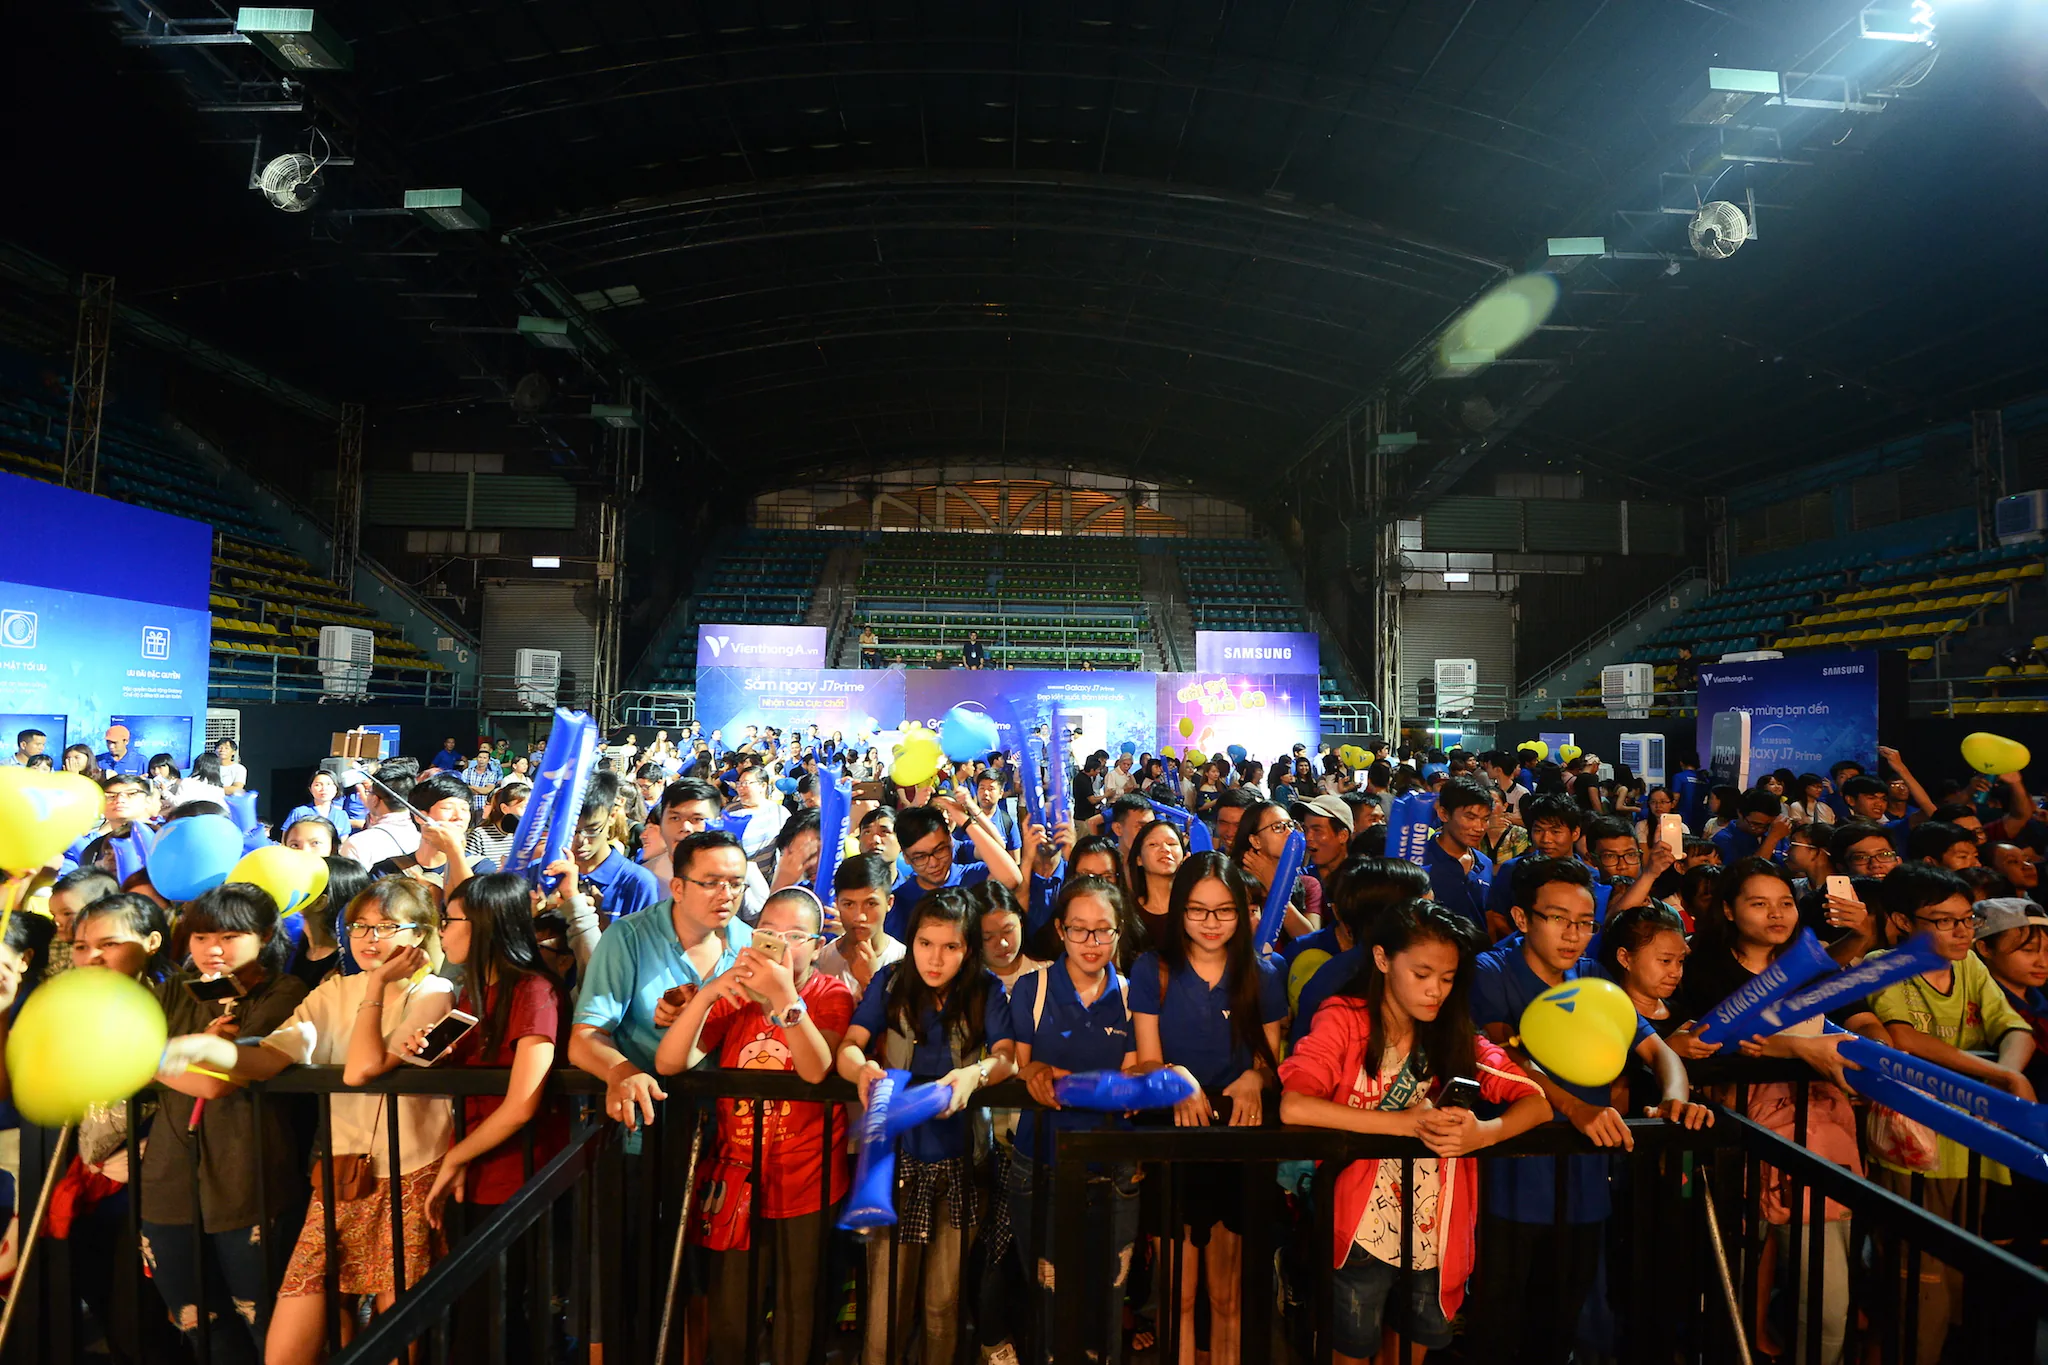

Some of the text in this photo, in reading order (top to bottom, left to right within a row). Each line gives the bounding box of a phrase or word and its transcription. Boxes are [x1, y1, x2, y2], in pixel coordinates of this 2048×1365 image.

[1670, 596, 1679, 609] B
[457, 649, 469, 663] C
[1224, 647, 1292, 660] SAMSUNG
[1823, 665, 1865, 677] SAMSUNG
[744, 674, 777, 691] Sắm
[780, 680, 816, 695] ngay
[1065, 684, 1091, 692] Galaxy
[762, 699, 785, 709] Nhận
[823, 697, 845, 707] Chất
[1755, 704, 1784, 718] mừng
[1785, 704, 1807, 717] bạn
[1808, 701, 1830, 715] đến
[1780, 747, 1794, 760] J7
[1795, 750, 1823, 761] Prime
[1410, 823, 1428, 865] SUNG
[1716, 964, 1789, 1024] SAMSUNG
[1879, 1057, 1989, 1117] SAMSUNG
[864, 1078, 895, 1144] SAMSUNG
